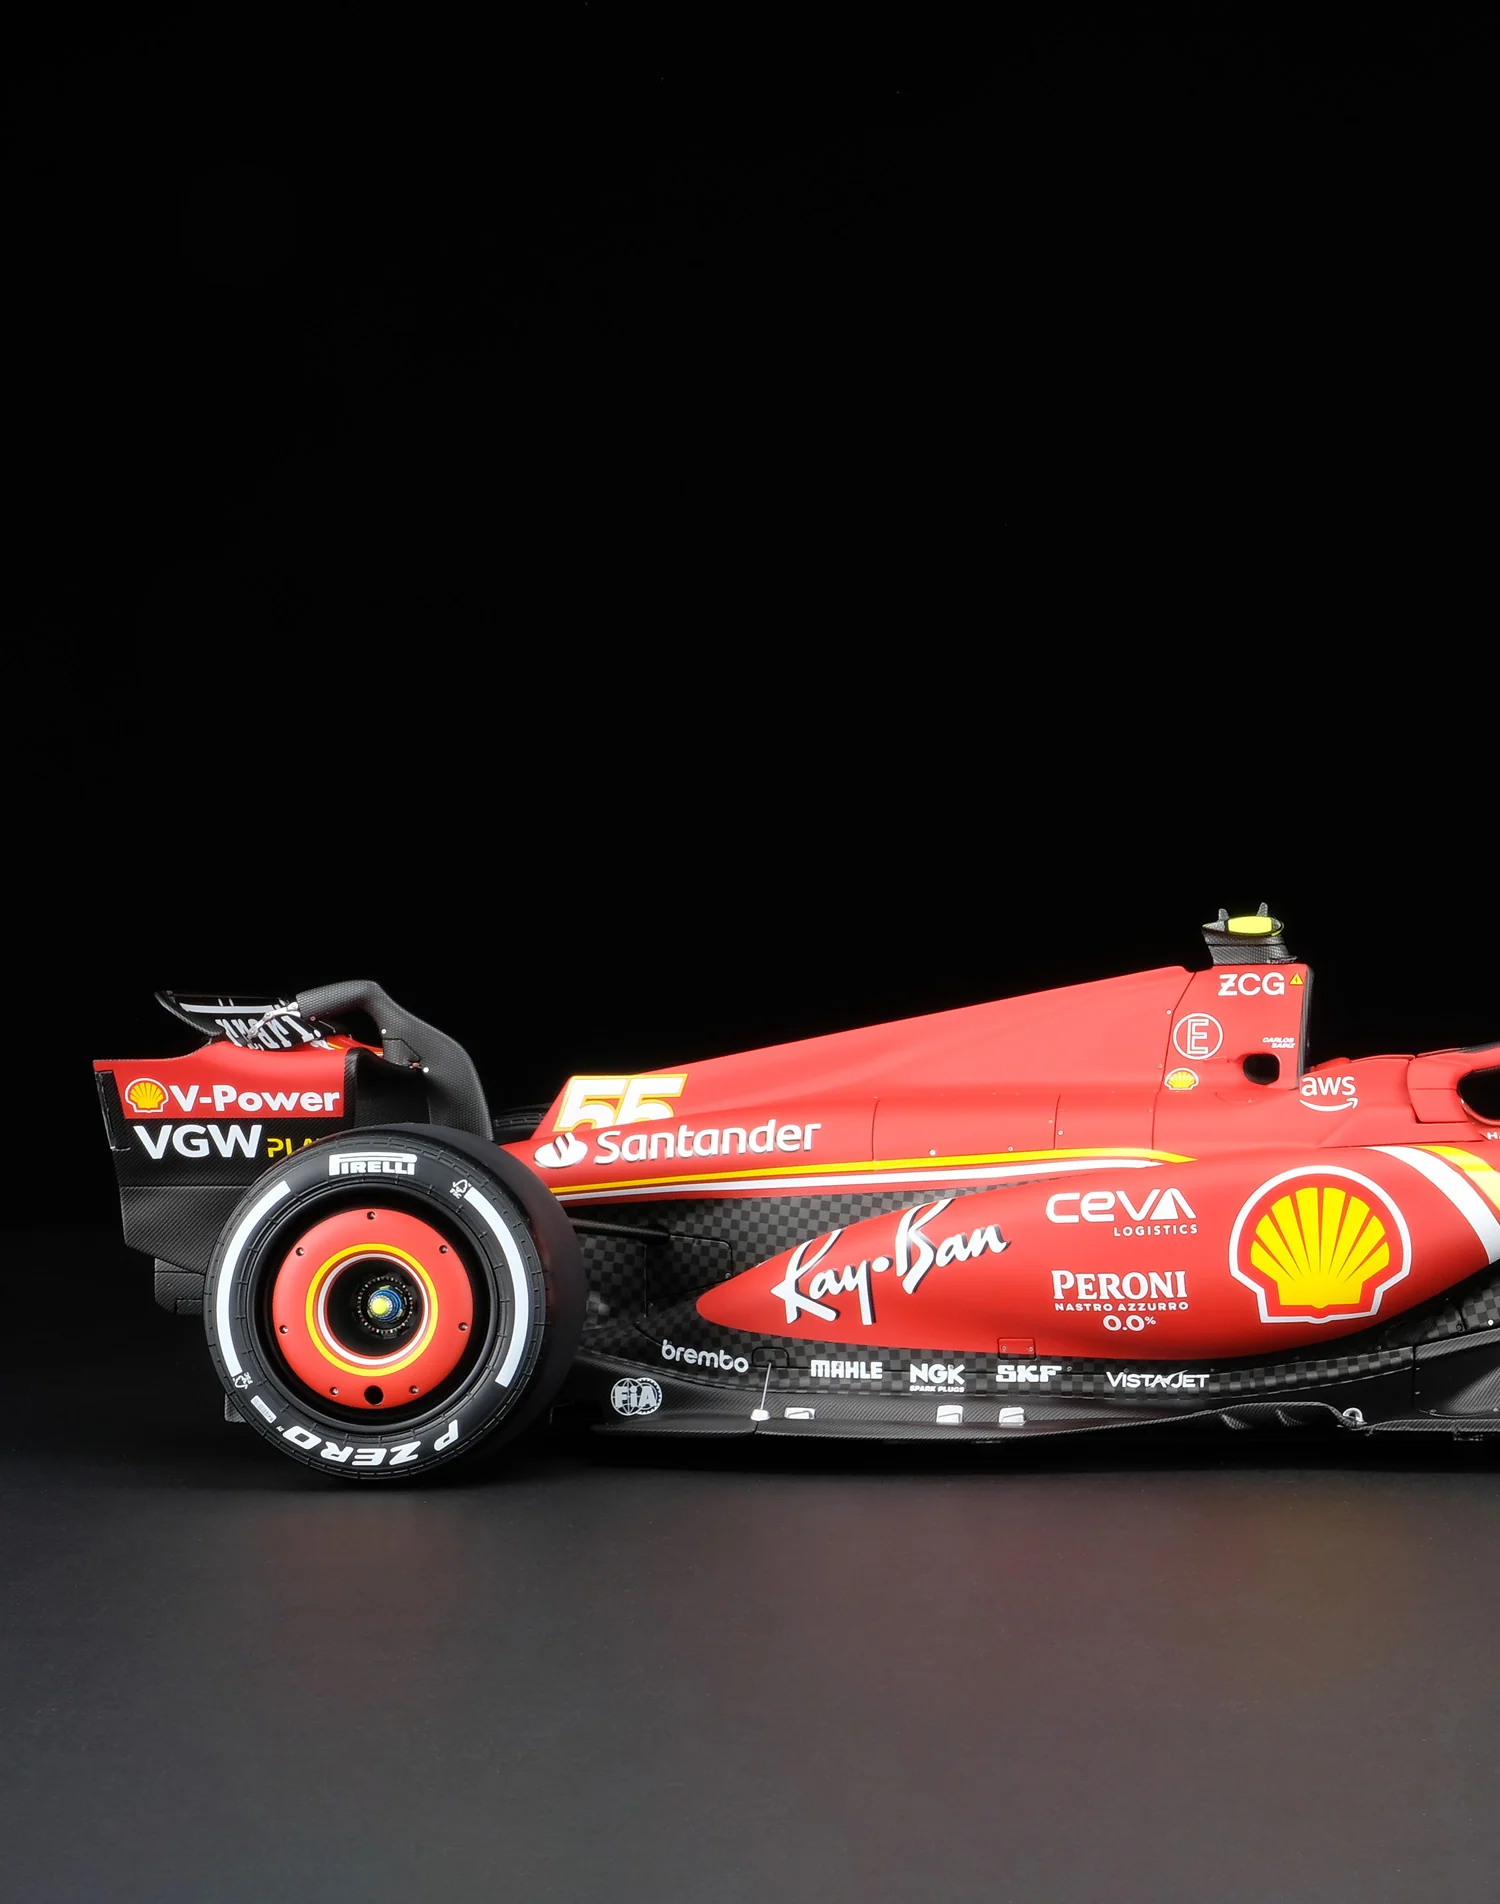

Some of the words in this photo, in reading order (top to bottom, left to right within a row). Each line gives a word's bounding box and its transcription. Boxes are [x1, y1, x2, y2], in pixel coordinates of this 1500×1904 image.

[1301, 1076, 1356, 1097] aws
[169, 1085, 340, 1112] V-Power
[133, 1124, 263, 1159] VGW
[593, 1119, 822, 1165] Santander
[329, 1151, 417, 1176] PIRELLI
[1113, 1223, 1198, 1238] LOGISTICS
[1051, 1270, 1188, 1300] PERONI
[1054, 1302, 1113, 1312] NASTRO
[1117, 1301, 1189, 1311] AZZURRO
[1102, 1315, 1157, 1331] 0.0%
[661, 1339, 749, 1373] brembo
[810, 1359, 883, 1380] MAHLE
[909, 1363, 966, 1385] NGK
[995, 1364, 1062, 1383] SKF
[909, 1384, 936, 1393] SPARK
[937, 1385, 965, 1393] PLUGS
[433, 1419, 459, 1451] P
